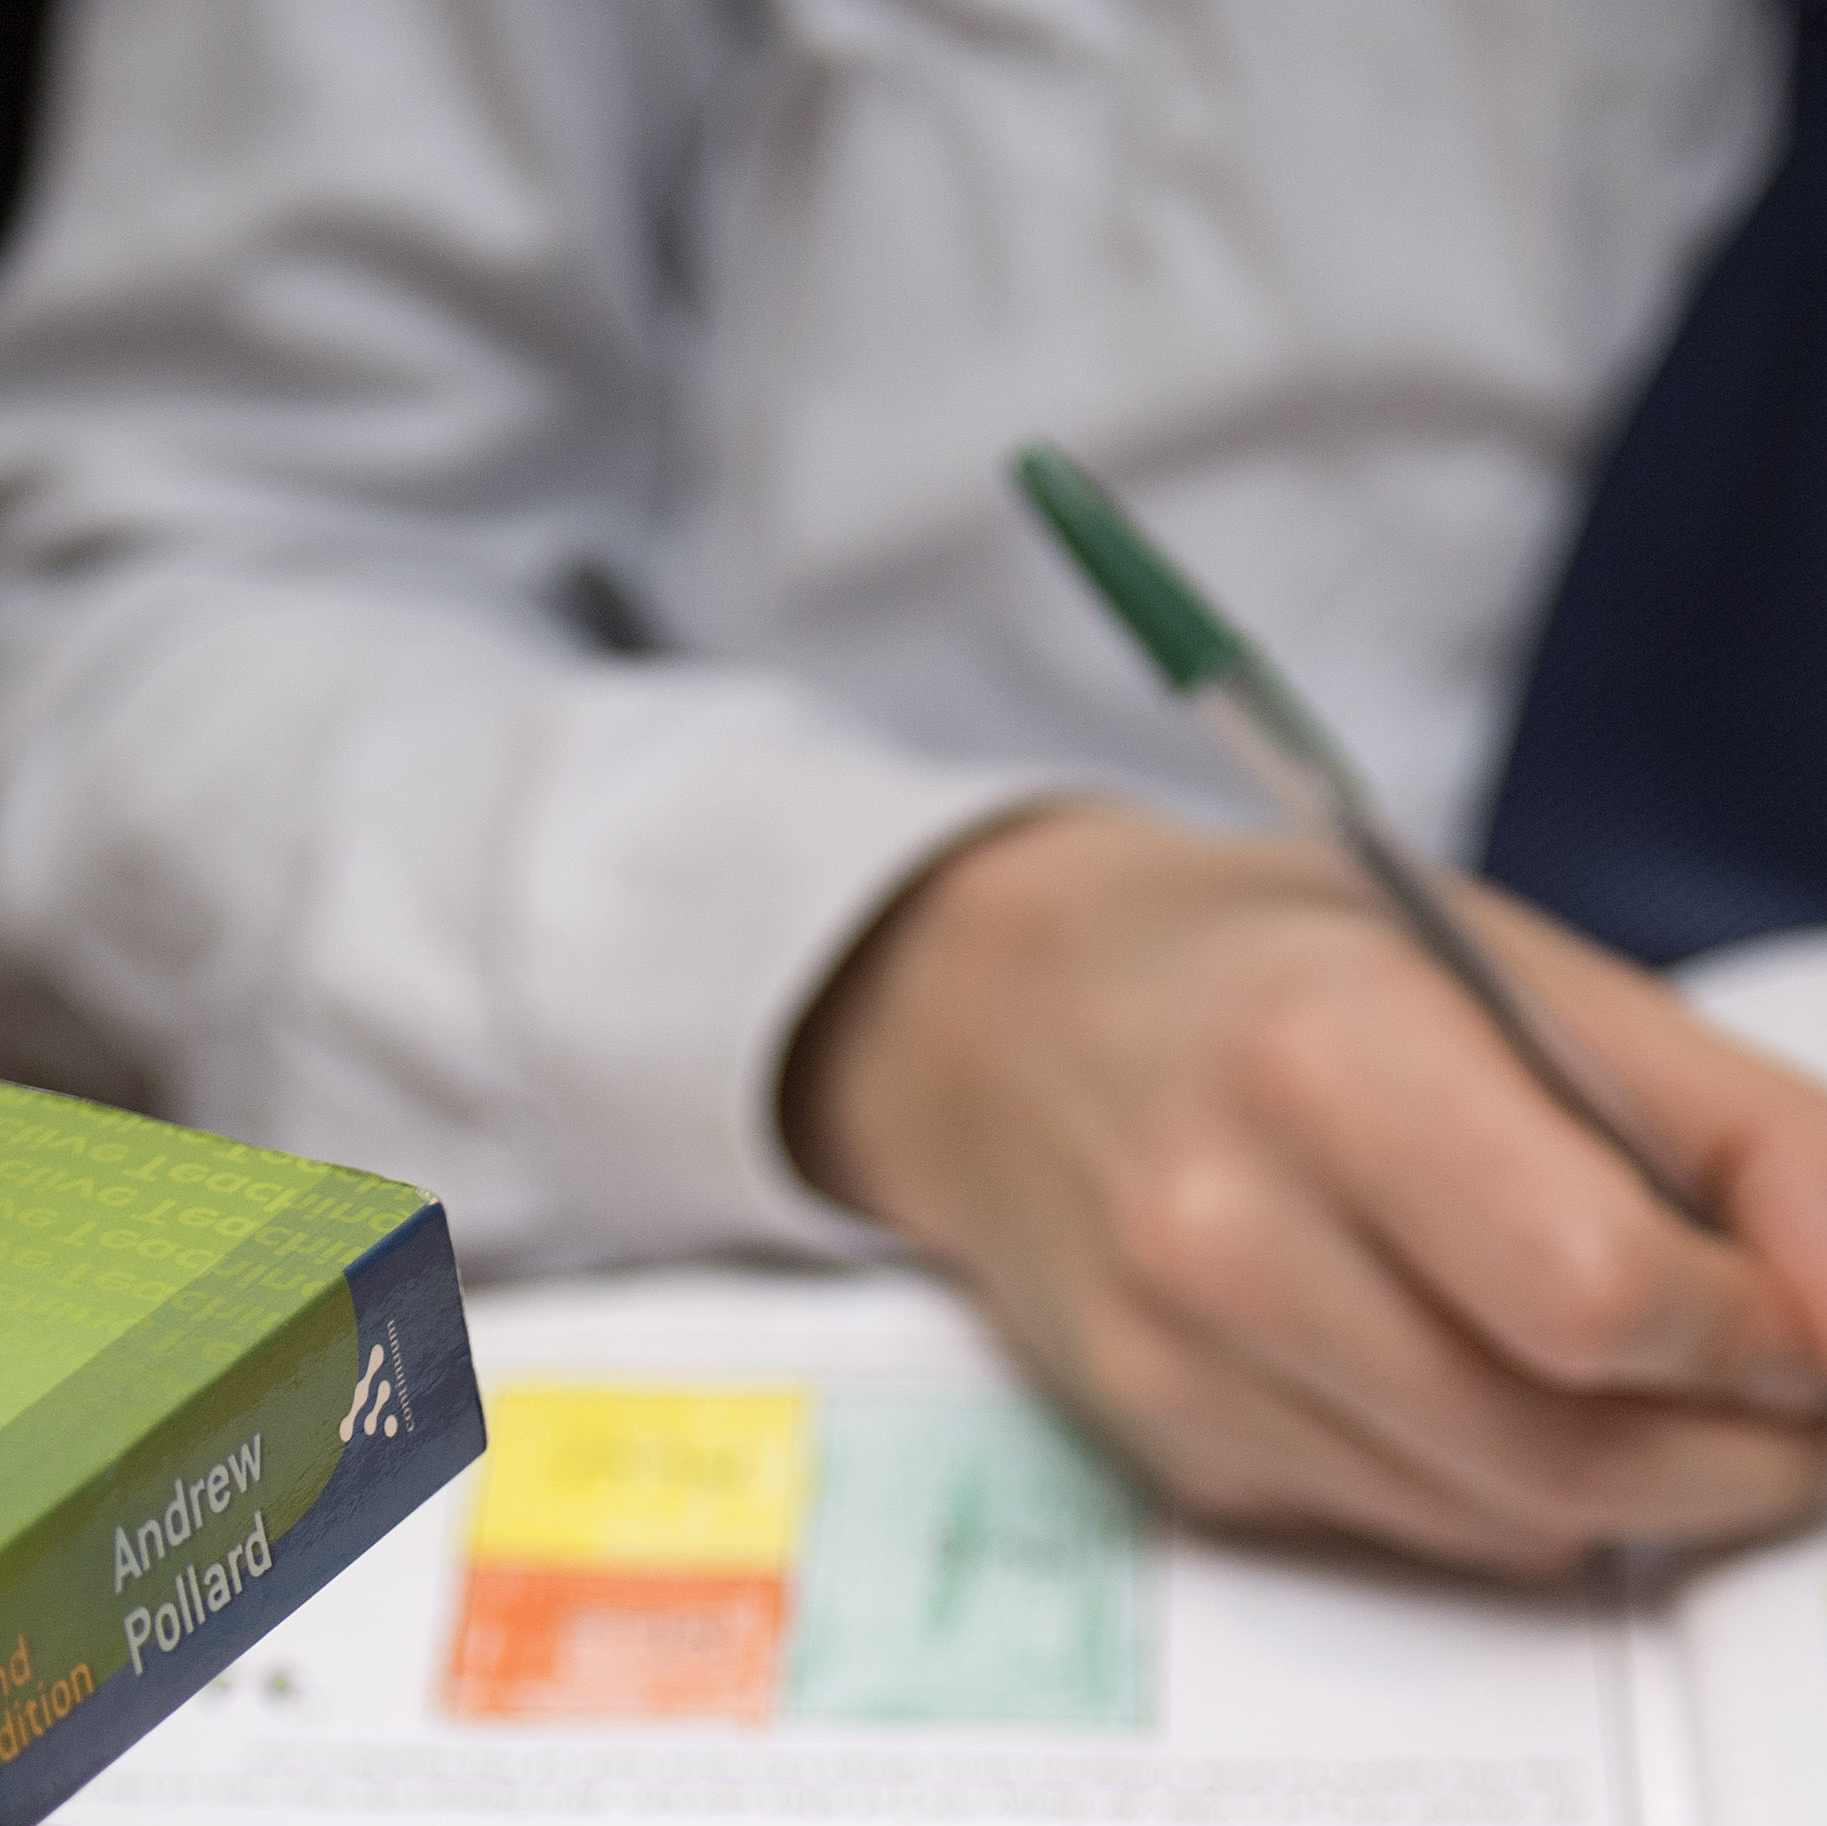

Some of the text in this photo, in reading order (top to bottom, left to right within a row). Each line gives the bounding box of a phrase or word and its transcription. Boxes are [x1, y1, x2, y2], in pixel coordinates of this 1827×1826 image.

[385, 1318, 415, 1433] continuum
[113, 1432, 265, 1594] Andrew
[123, 1510, 274, 1677] Pollard
